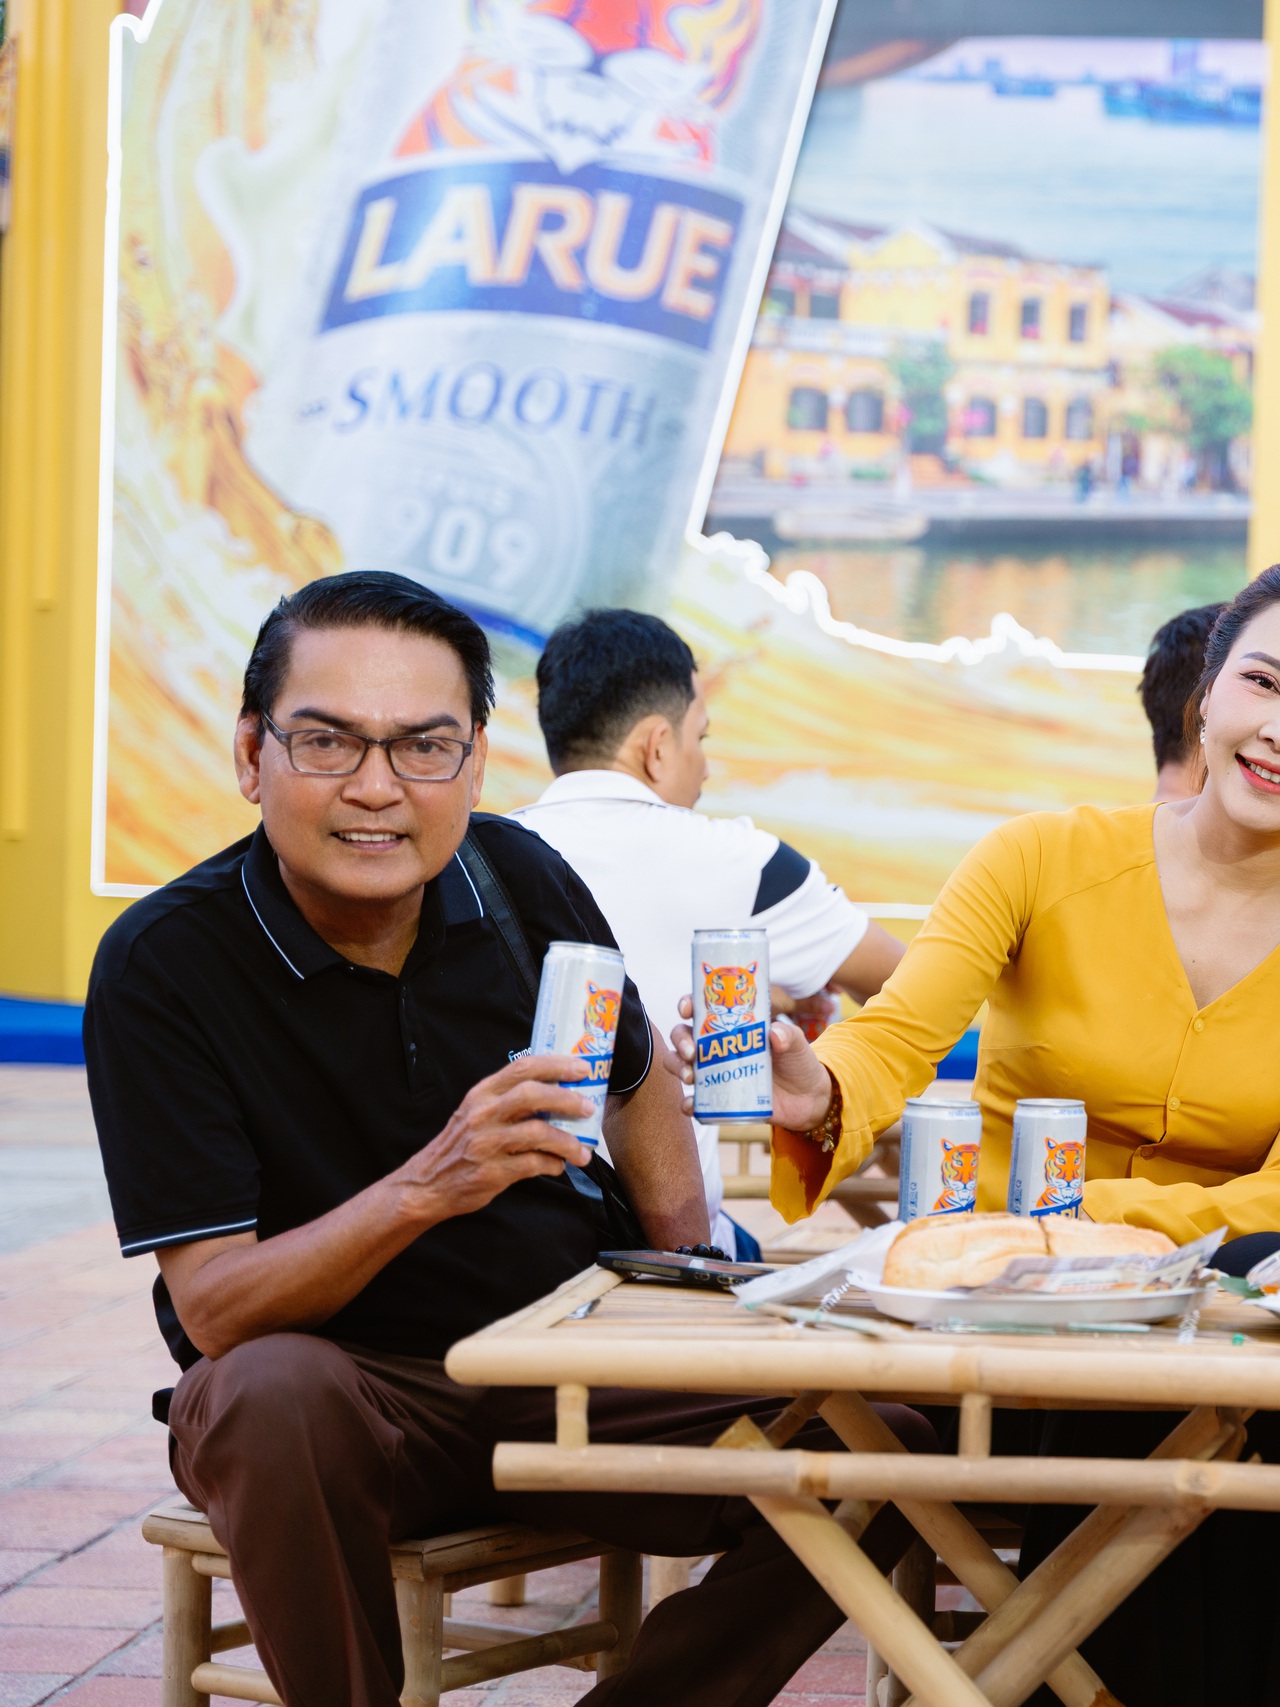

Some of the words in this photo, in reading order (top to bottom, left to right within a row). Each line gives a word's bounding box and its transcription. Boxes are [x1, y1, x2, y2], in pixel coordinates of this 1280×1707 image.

[344, 182, 733, 322] LARUE
[334, 358, 656, 449] SMOOTH
[699, 1028, 763, 1063] LARUE
[704, 1063, 758, 1088] SMOOTH
